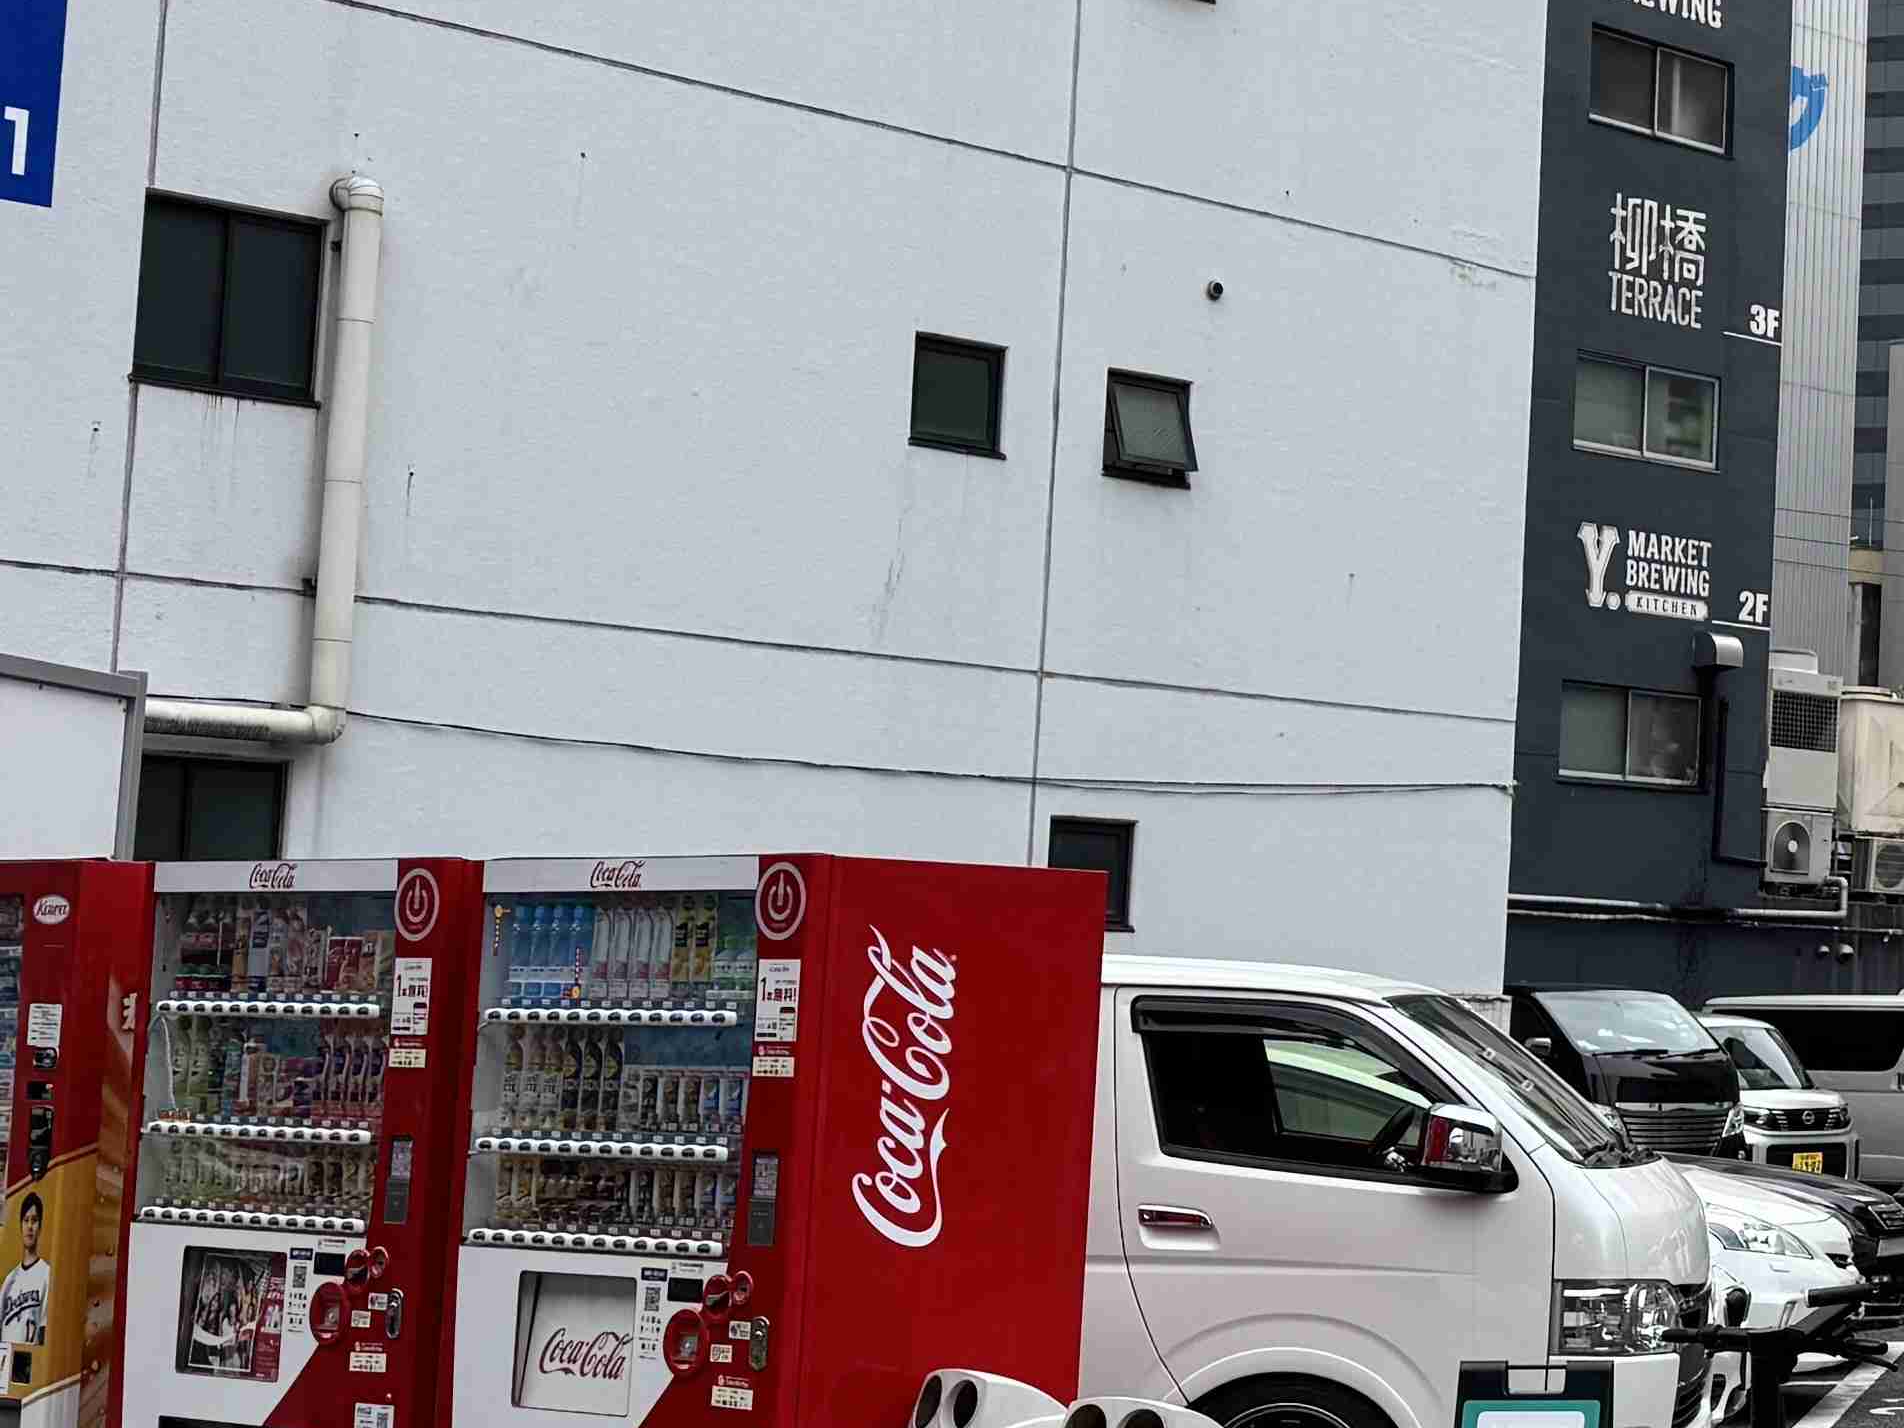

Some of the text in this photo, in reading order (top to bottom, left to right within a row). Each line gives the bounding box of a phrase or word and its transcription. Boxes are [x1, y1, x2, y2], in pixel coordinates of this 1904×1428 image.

[1609, 192, 1706, 286] 柳橋
[1608, 271, 1703, 329] TERRACE
[1749, 304, 1780, 338] 3F
[1627, 530, 1713, 568] MARKET
[1625, 560, 1710, 597] BREWING
[1635, 595, 1700, 617] KITCHEN
[1739, 592, 1769, 624] 2F
